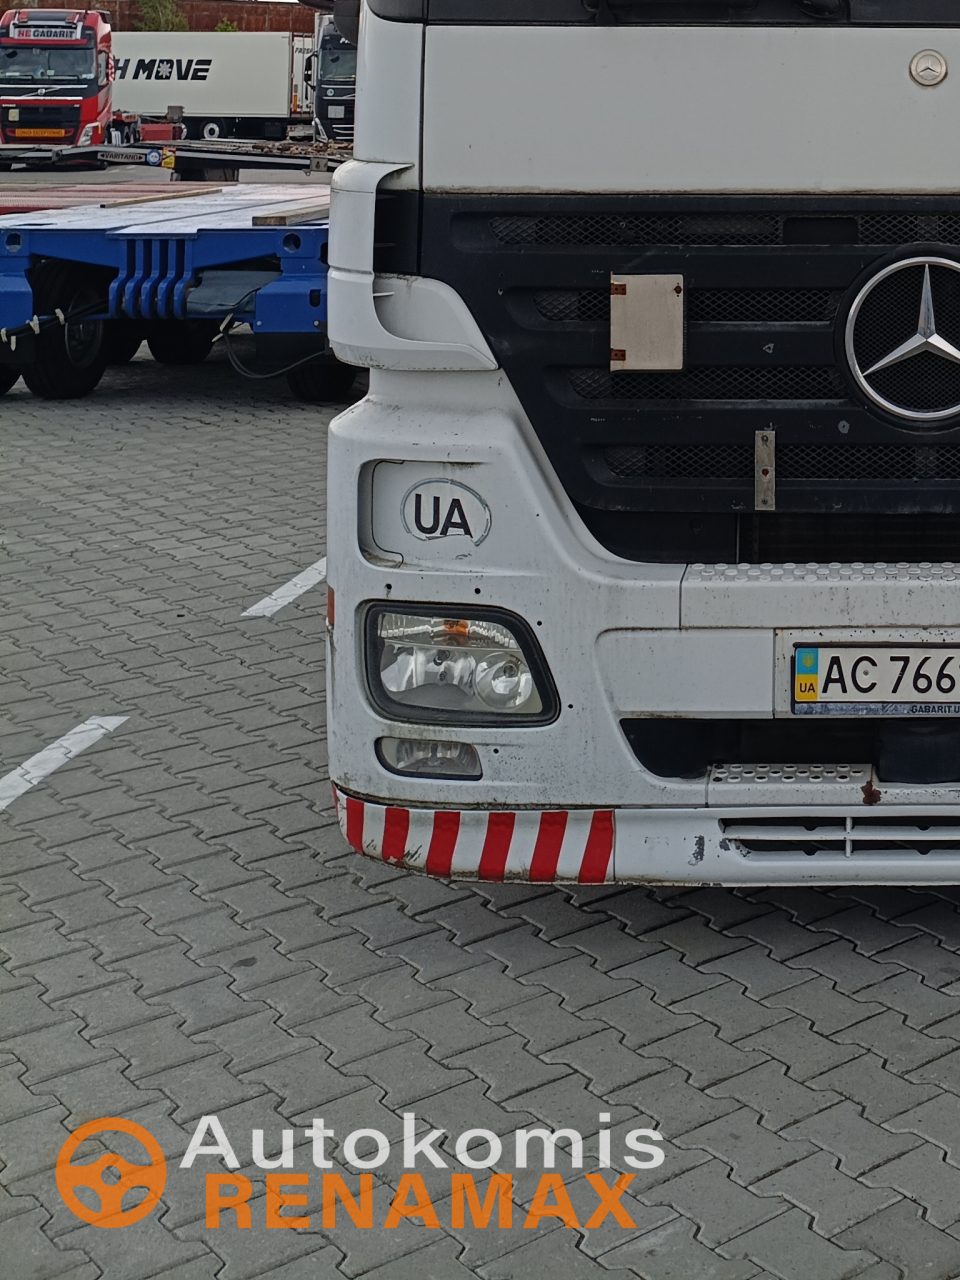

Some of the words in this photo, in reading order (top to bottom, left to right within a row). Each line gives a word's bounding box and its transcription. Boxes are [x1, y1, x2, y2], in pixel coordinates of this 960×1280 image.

[132, 58, 213, 81] MOVE
[414, 493, 473, 538] UA
[799, 682, 816, 693] UA
[822, 655, 878, 694] AC
